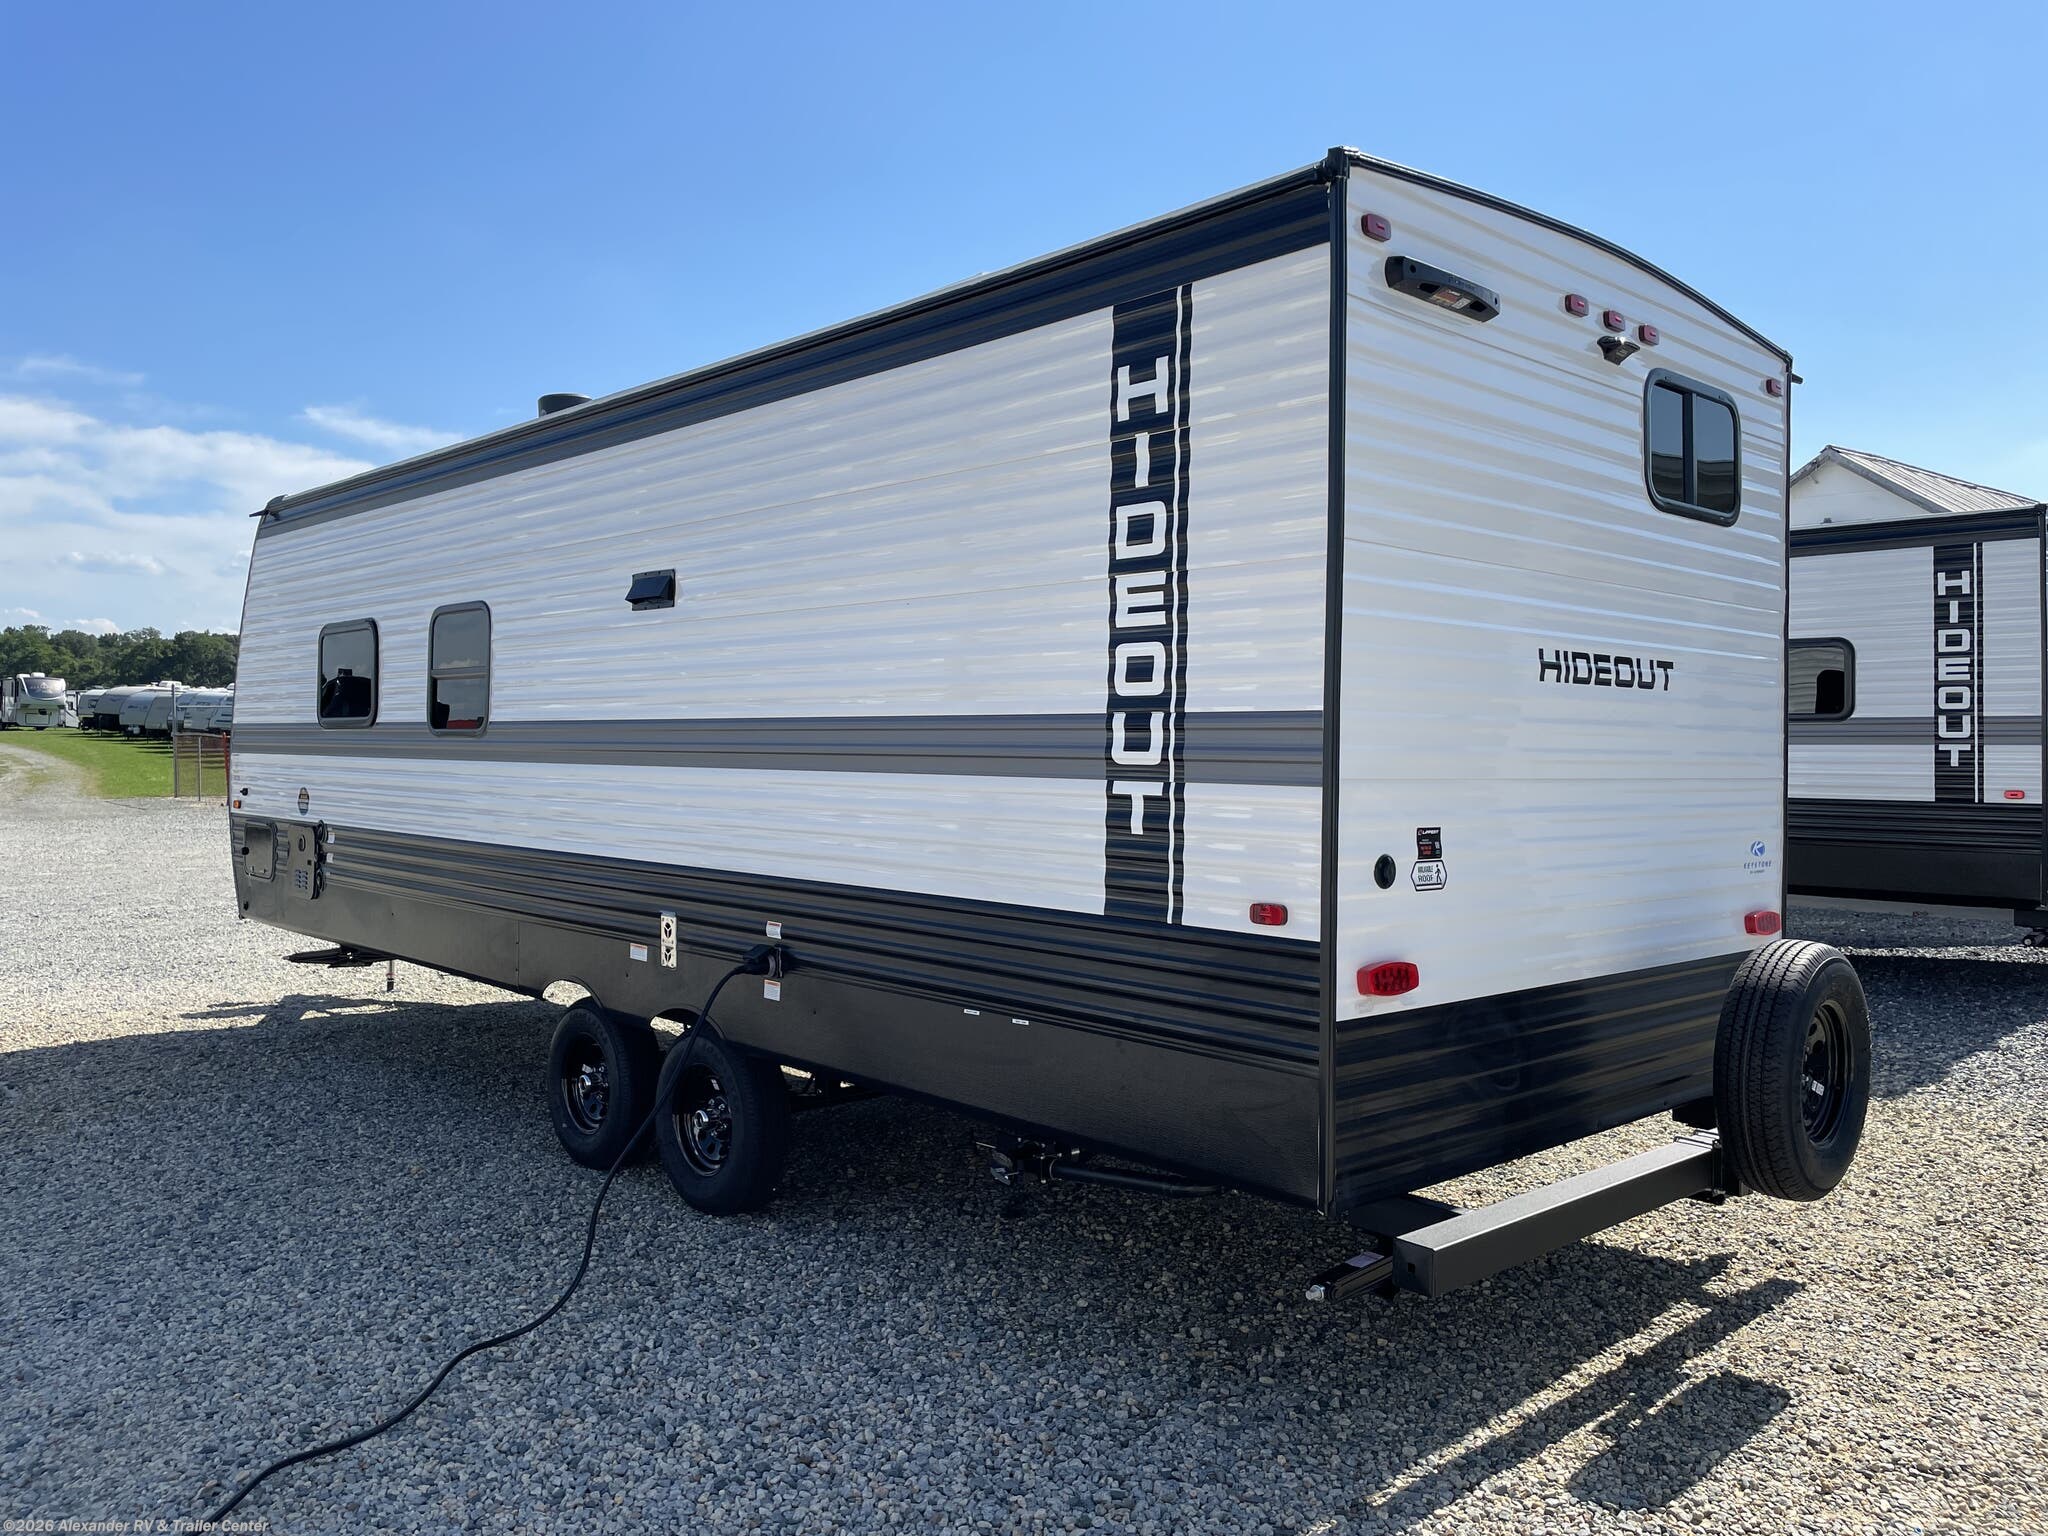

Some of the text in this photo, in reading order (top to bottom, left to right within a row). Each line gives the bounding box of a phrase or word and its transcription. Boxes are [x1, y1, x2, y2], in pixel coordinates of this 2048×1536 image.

[1111, 355, 1171, 835] HIDEOUT
[1537, 647, 1674, 692] HIDEOUT
[1936, 569, 1972, 767] HIDEOUT
[1417, 874, 1433, 882] ROOF
